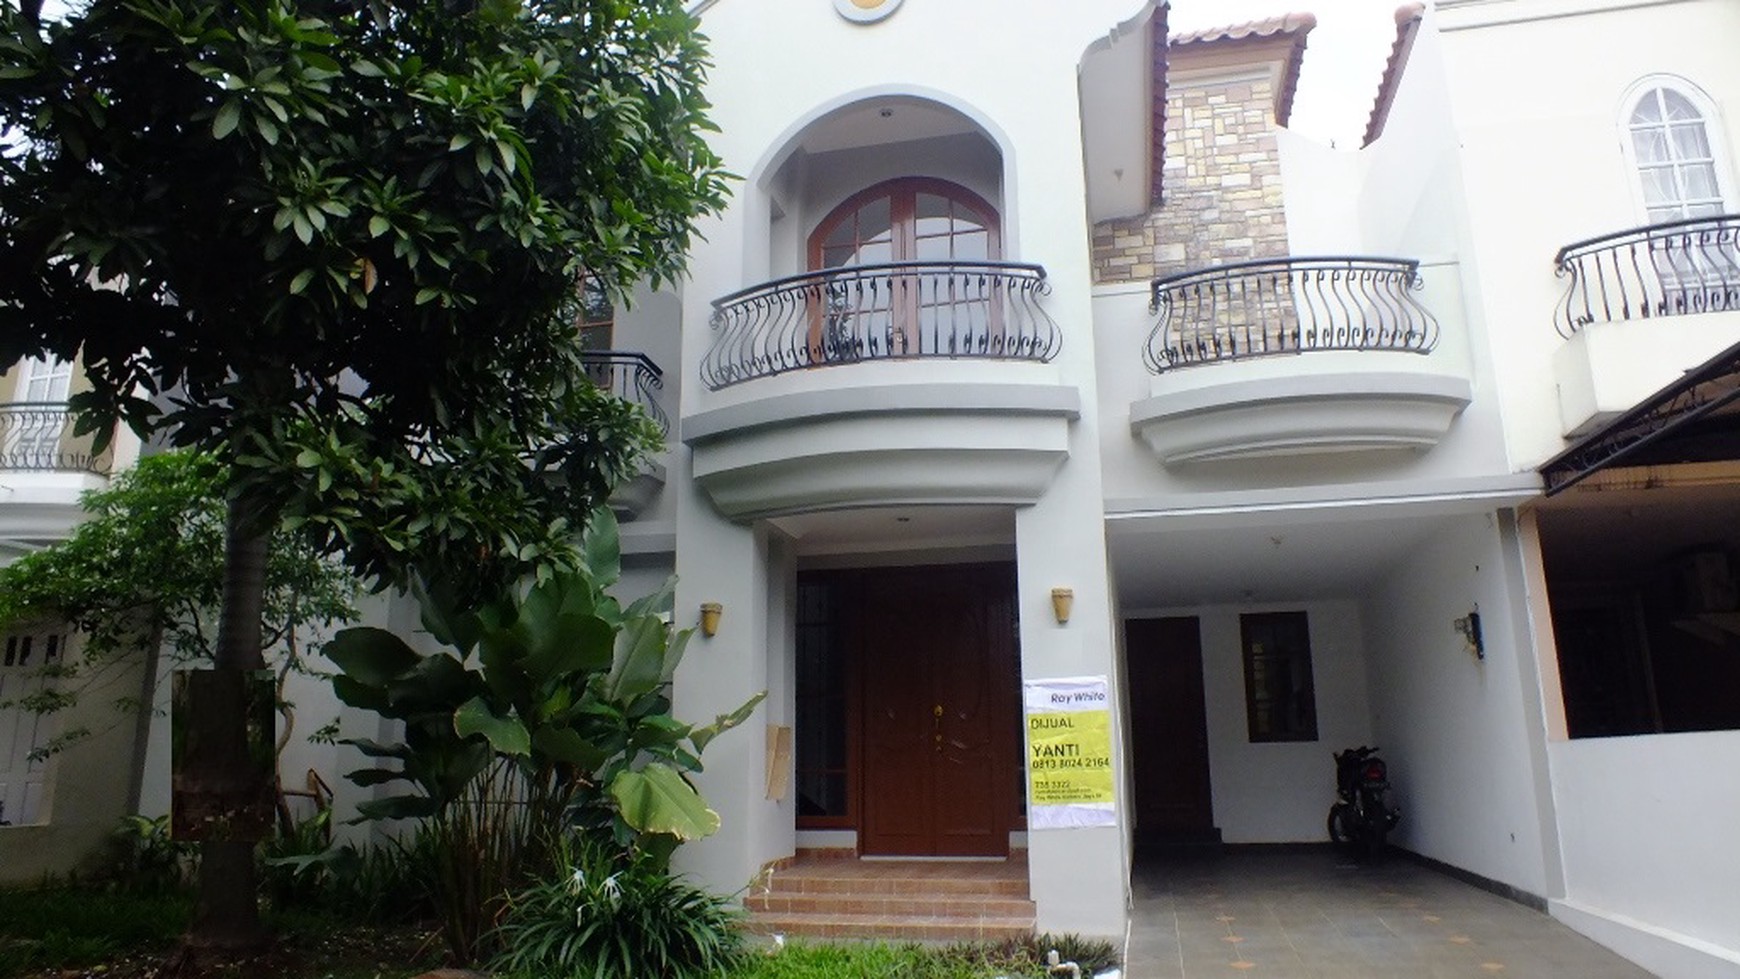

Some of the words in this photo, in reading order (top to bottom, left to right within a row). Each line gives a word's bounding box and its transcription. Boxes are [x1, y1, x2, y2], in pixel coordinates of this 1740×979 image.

[1074, 692, 1105, 702] White
[1031, 718, 1074, 729] DIJUAL
[1032, 744, 1079, 757] YANTI
[1032, 760, 1056, 769] 0813
